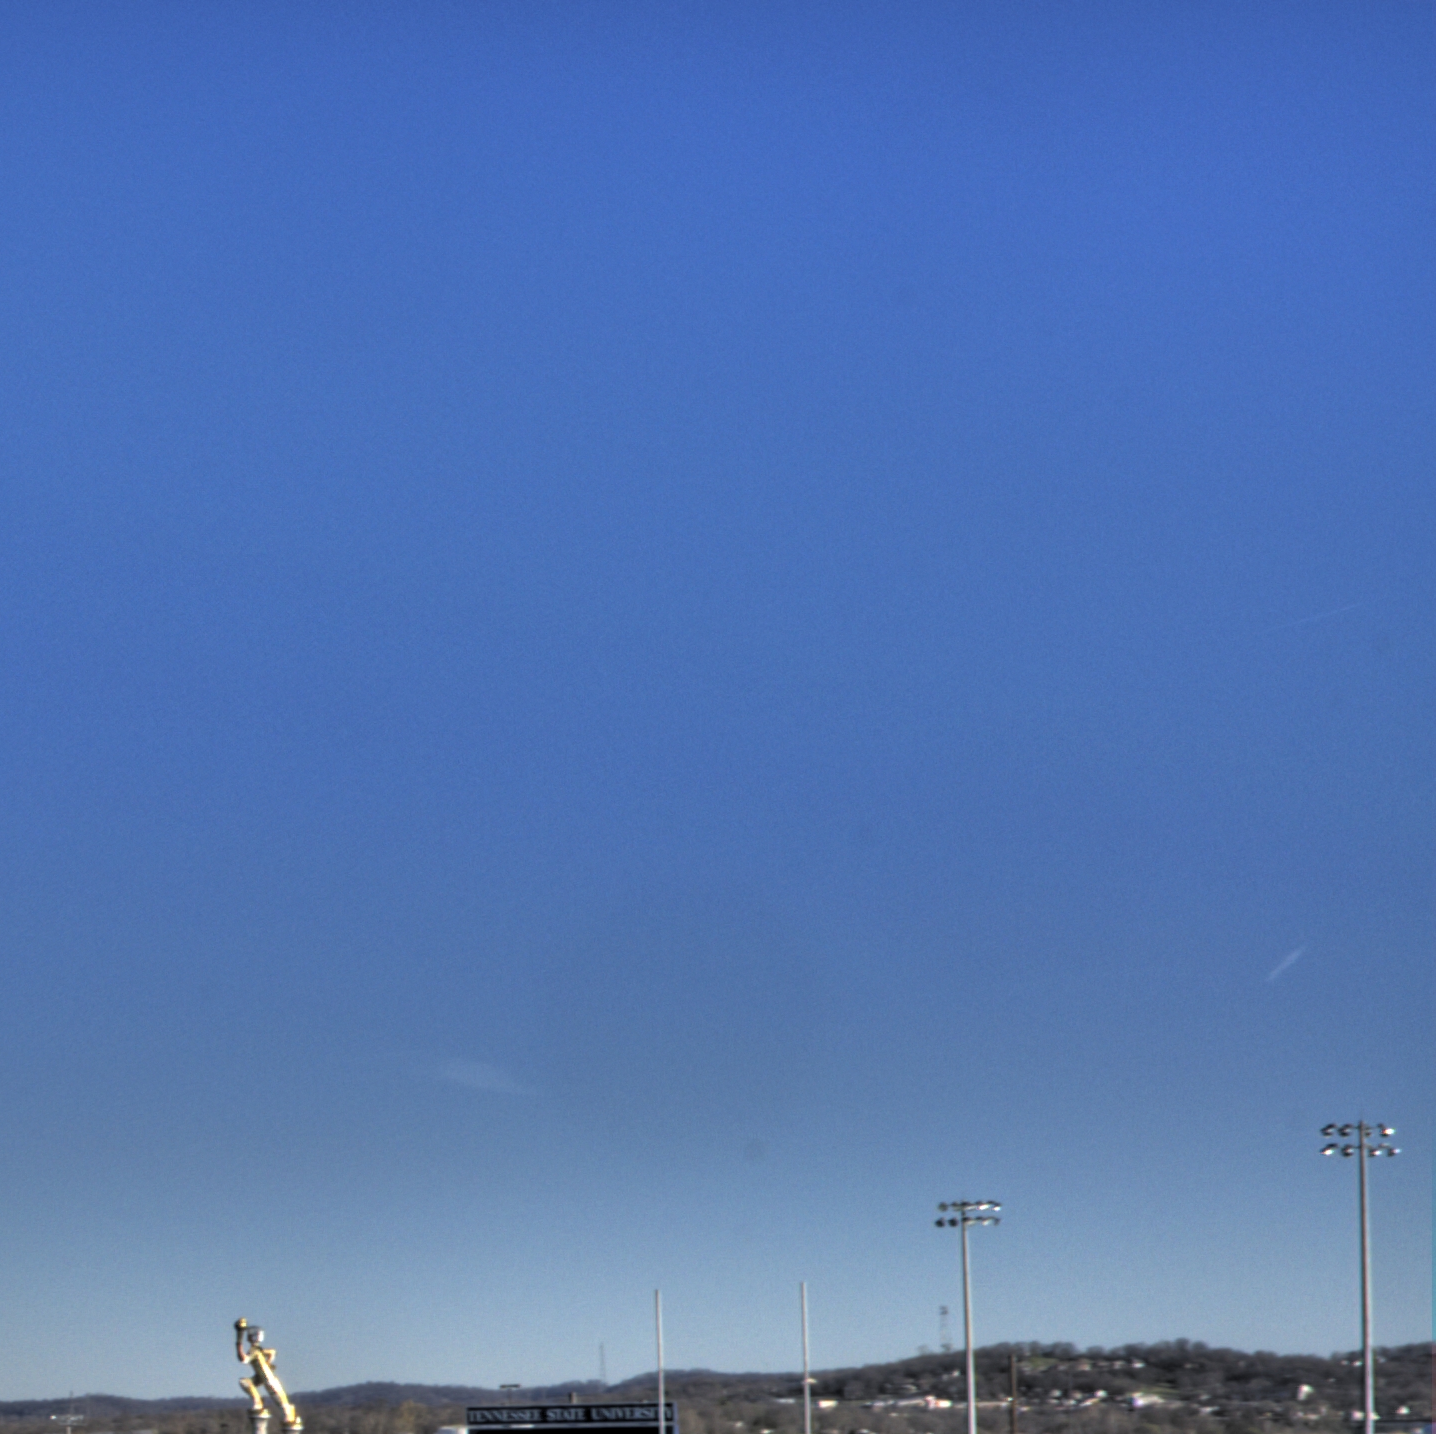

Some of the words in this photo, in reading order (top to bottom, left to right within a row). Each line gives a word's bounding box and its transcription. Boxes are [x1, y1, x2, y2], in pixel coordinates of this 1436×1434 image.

[468, 1409, 542, 1423] TENNESSEE
[546, 1408, 586, 1421] STATE
[590, 1407, 673, 1420] UNIVERSIY
